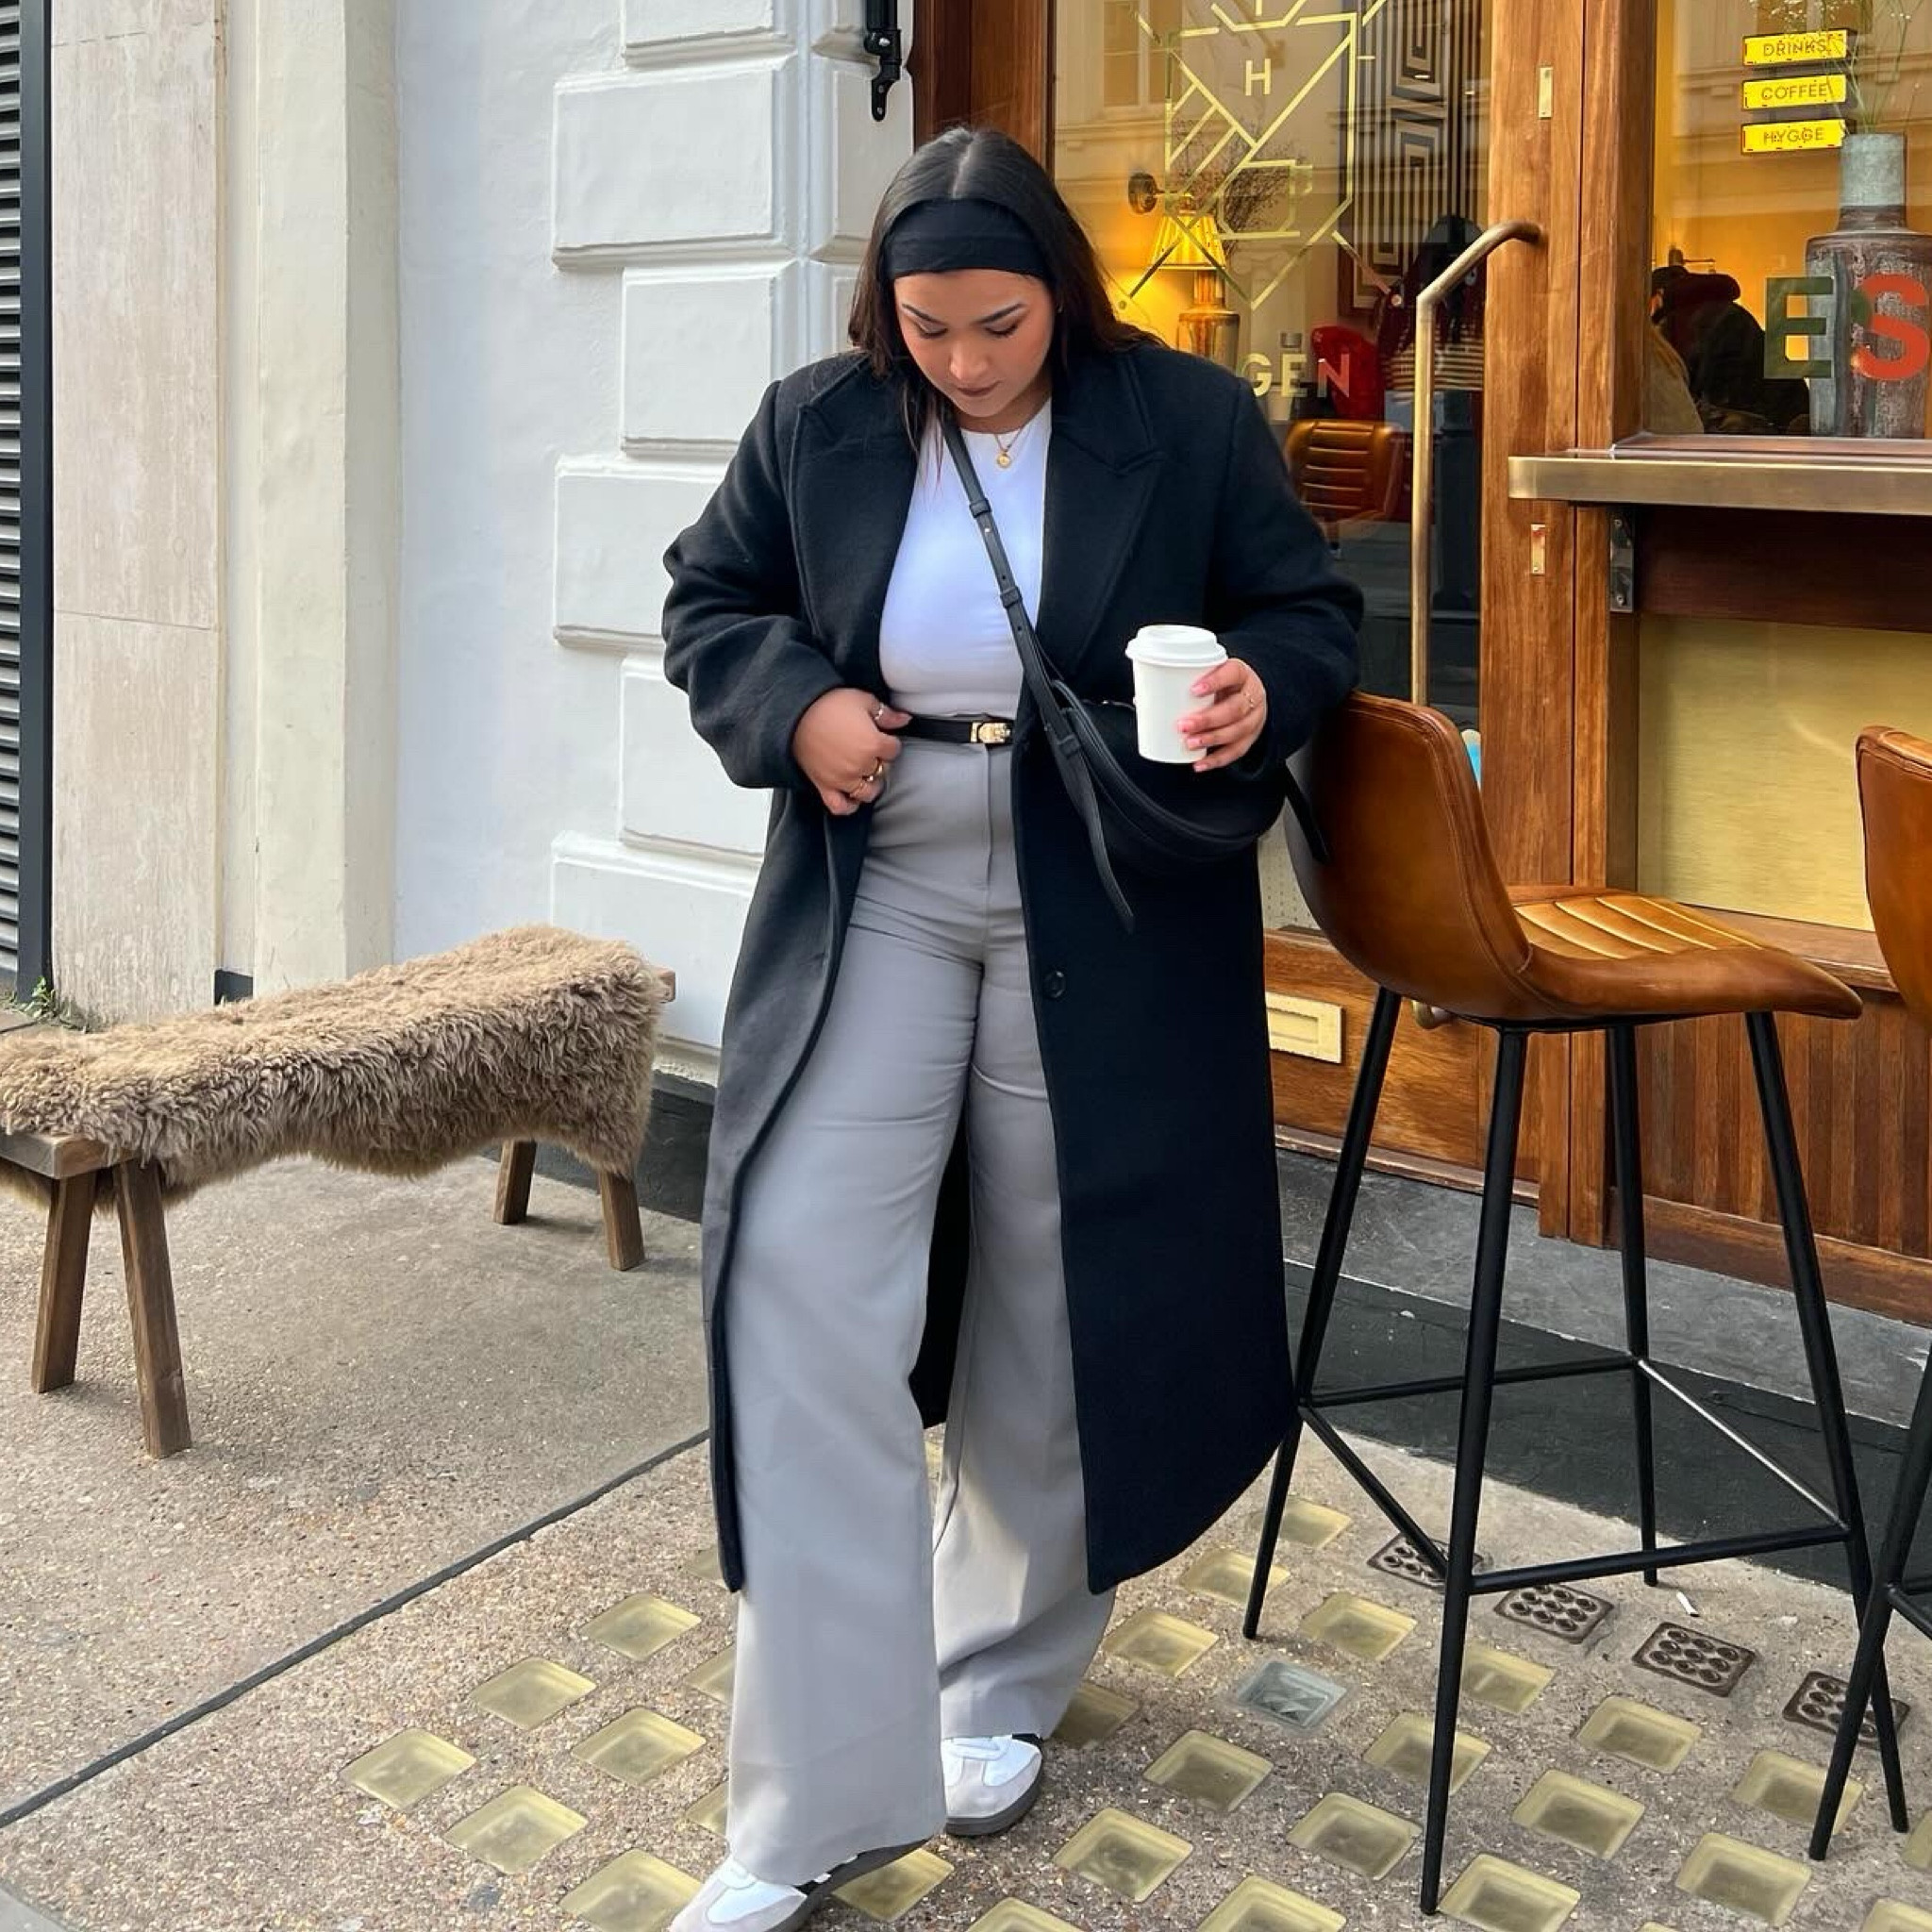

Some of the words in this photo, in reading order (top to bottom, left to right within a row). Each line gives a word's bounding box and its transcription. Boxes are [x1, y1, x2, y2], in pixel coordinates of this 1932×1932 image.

[1763, 39, 1827, 57] DRINKS
[1245, 58, 1271, 95] H
[1761, 82, 1828, 100] COFFEE
[1763, 126, 1825, 144] HYGGE
